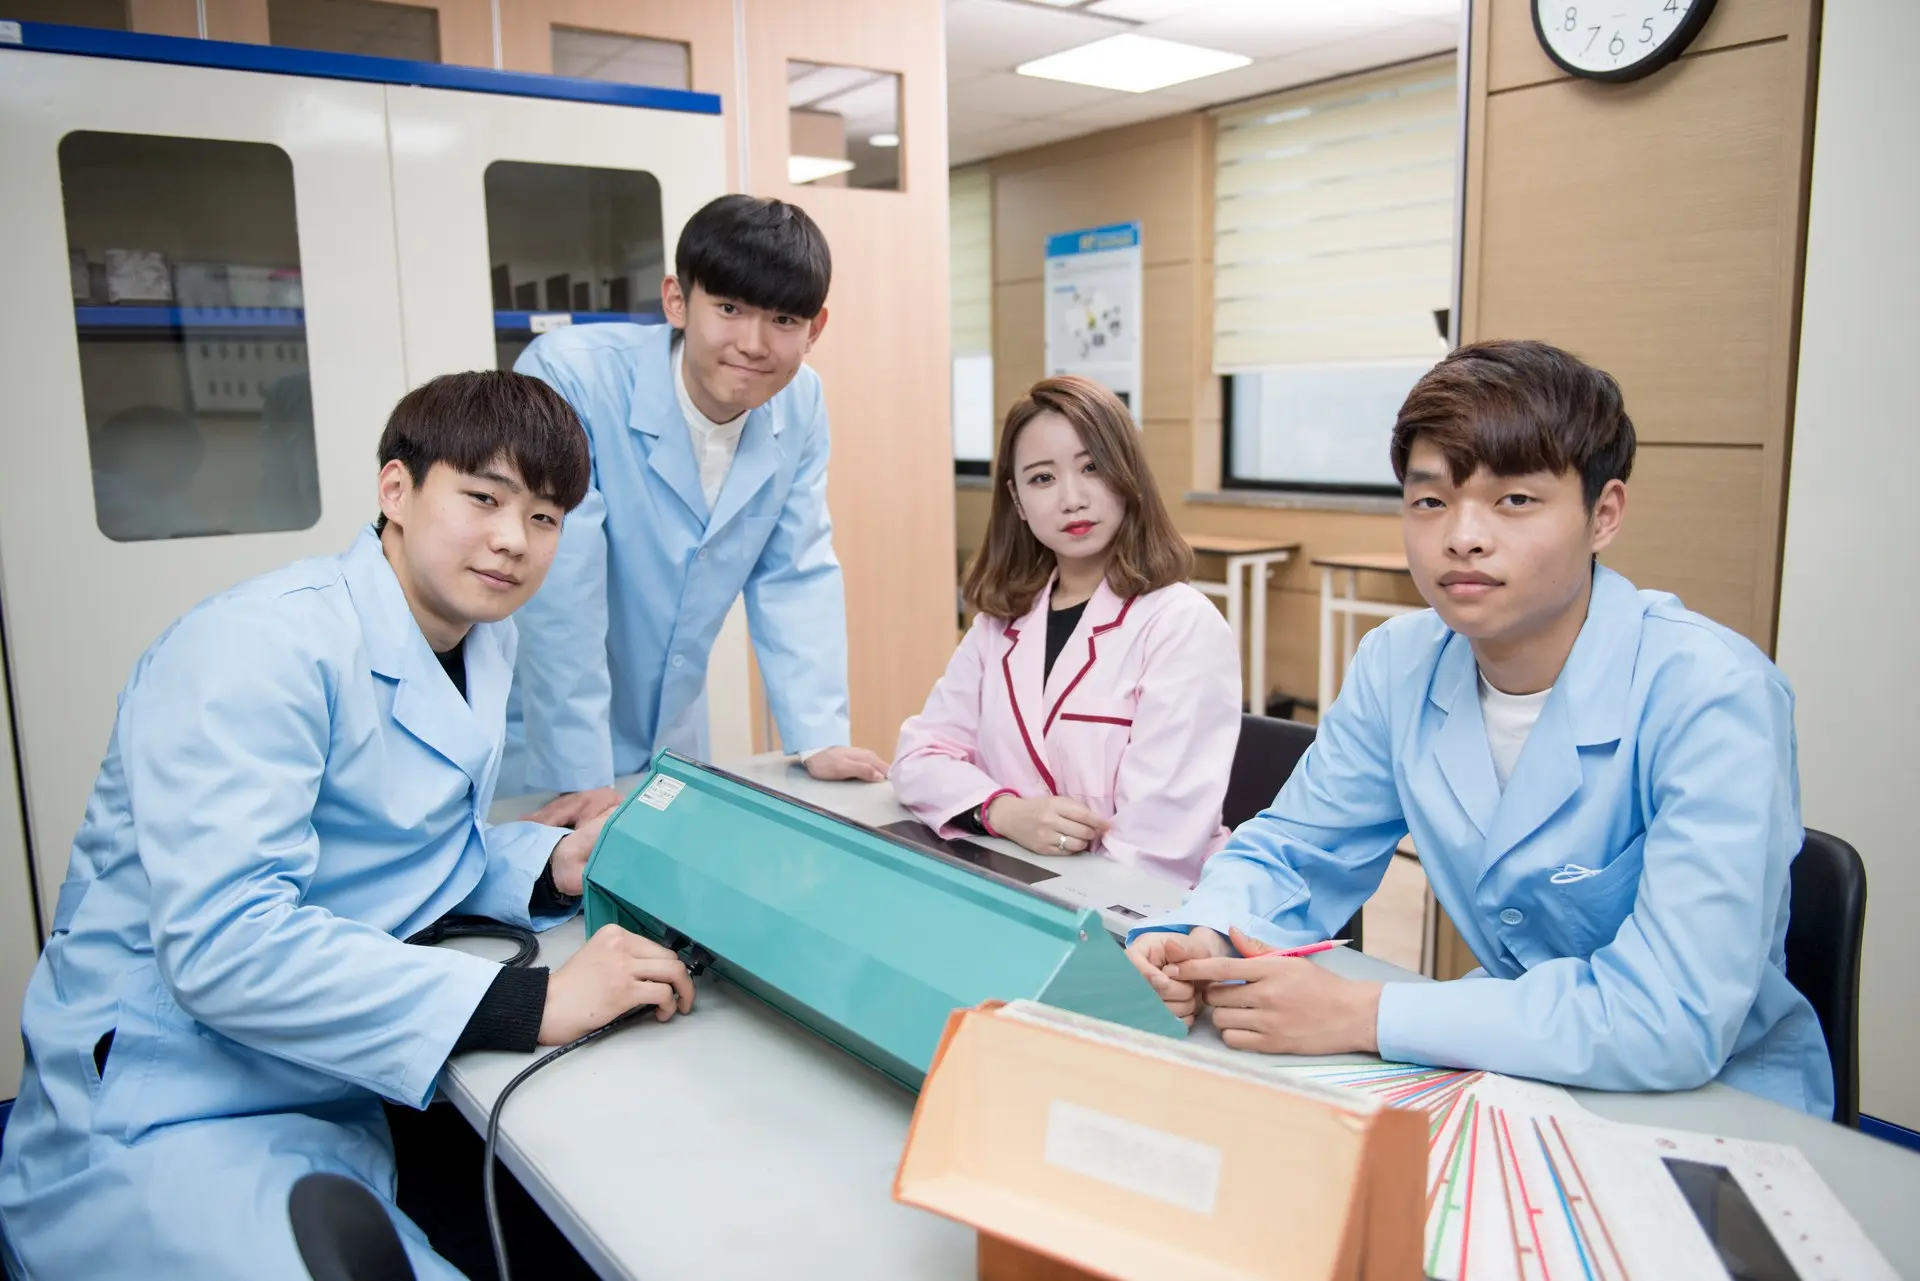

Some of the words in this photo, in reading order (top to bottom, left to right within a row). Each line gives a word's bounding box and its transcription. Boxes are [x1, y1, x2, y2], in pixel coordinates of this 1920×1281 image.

[1564, 6, 1578, 31] 8
[1638, 17, 1654, 43] 5
[1585, 26, 1601, 52] 7
[1608, 30, 1625, 55] 6
